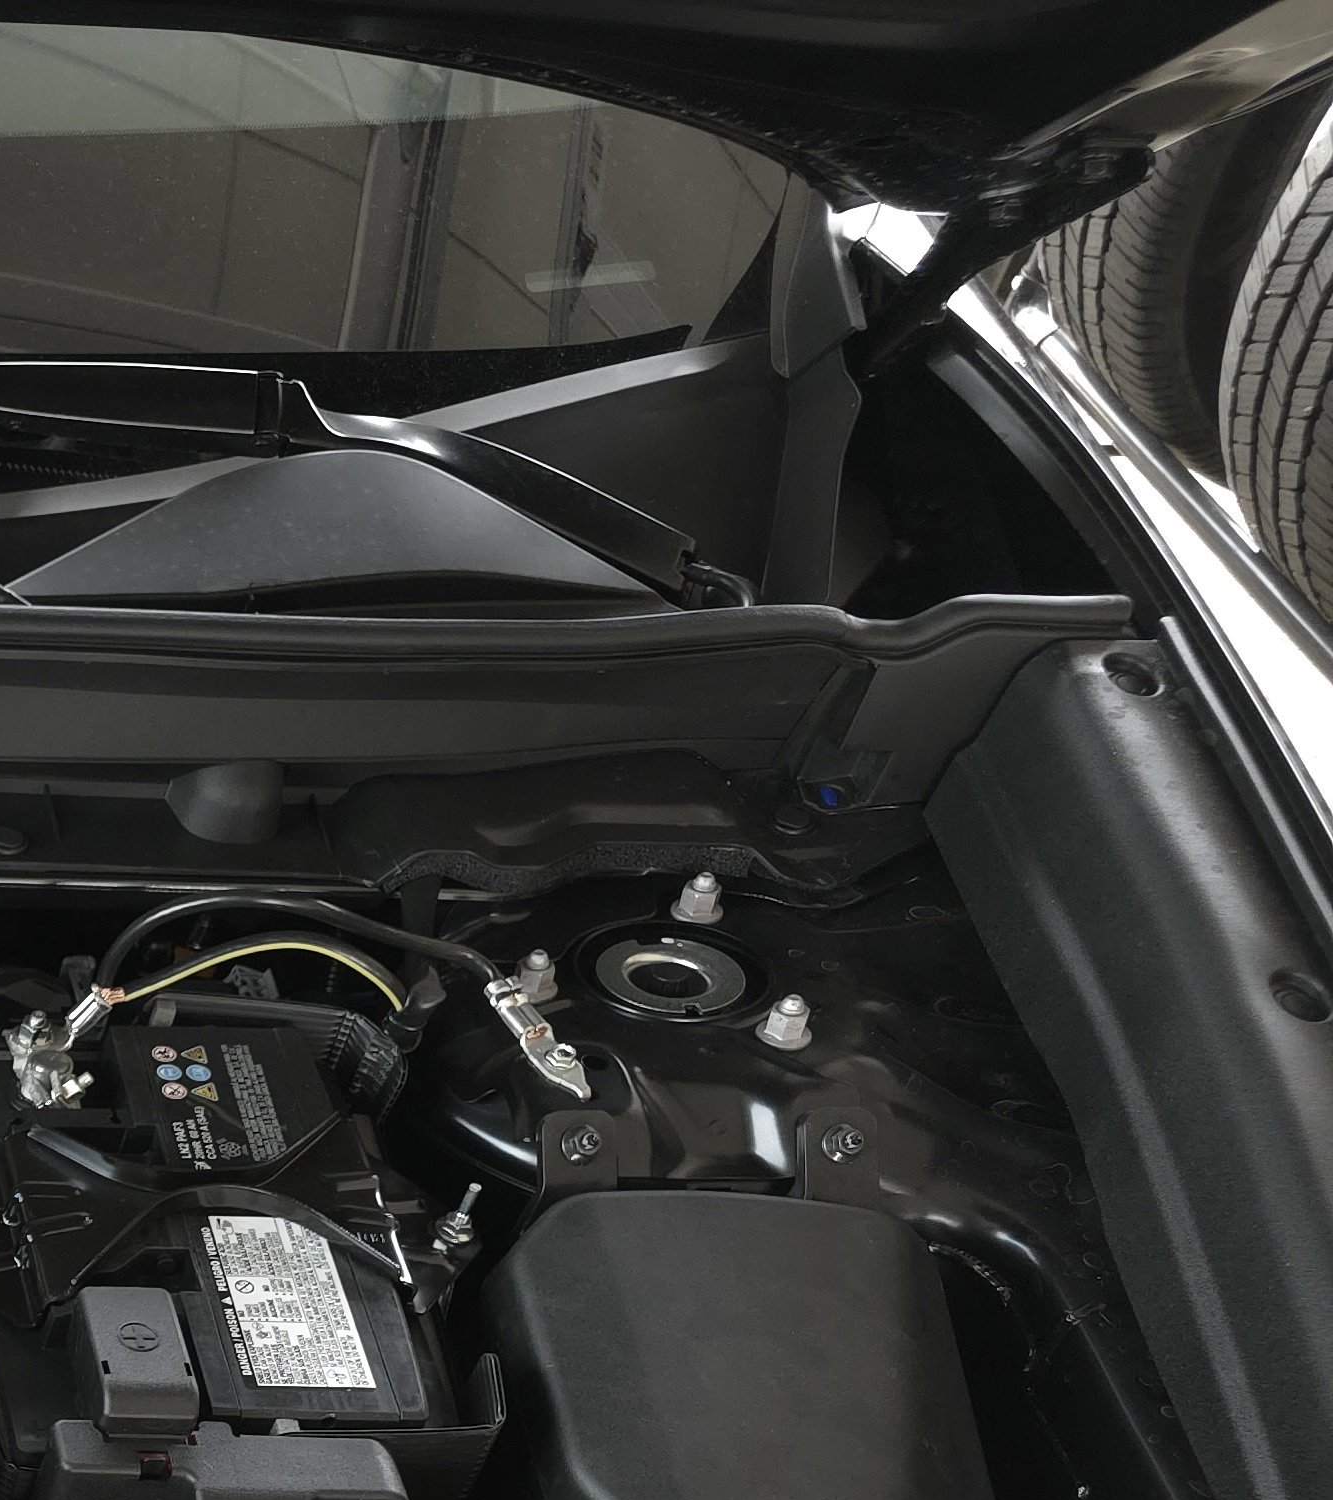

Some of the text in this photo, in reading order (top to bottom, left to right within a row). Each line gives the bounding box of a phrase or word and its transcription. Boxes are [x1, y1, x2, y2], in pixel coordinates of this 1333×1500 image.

[199, 1226, 217, 1255] VENENO
[209, 1260, 228, 1291] PELIGRO
[223, 1308, 241, 1337] POISON
[233, 1342, 253, 1375] DANGER
